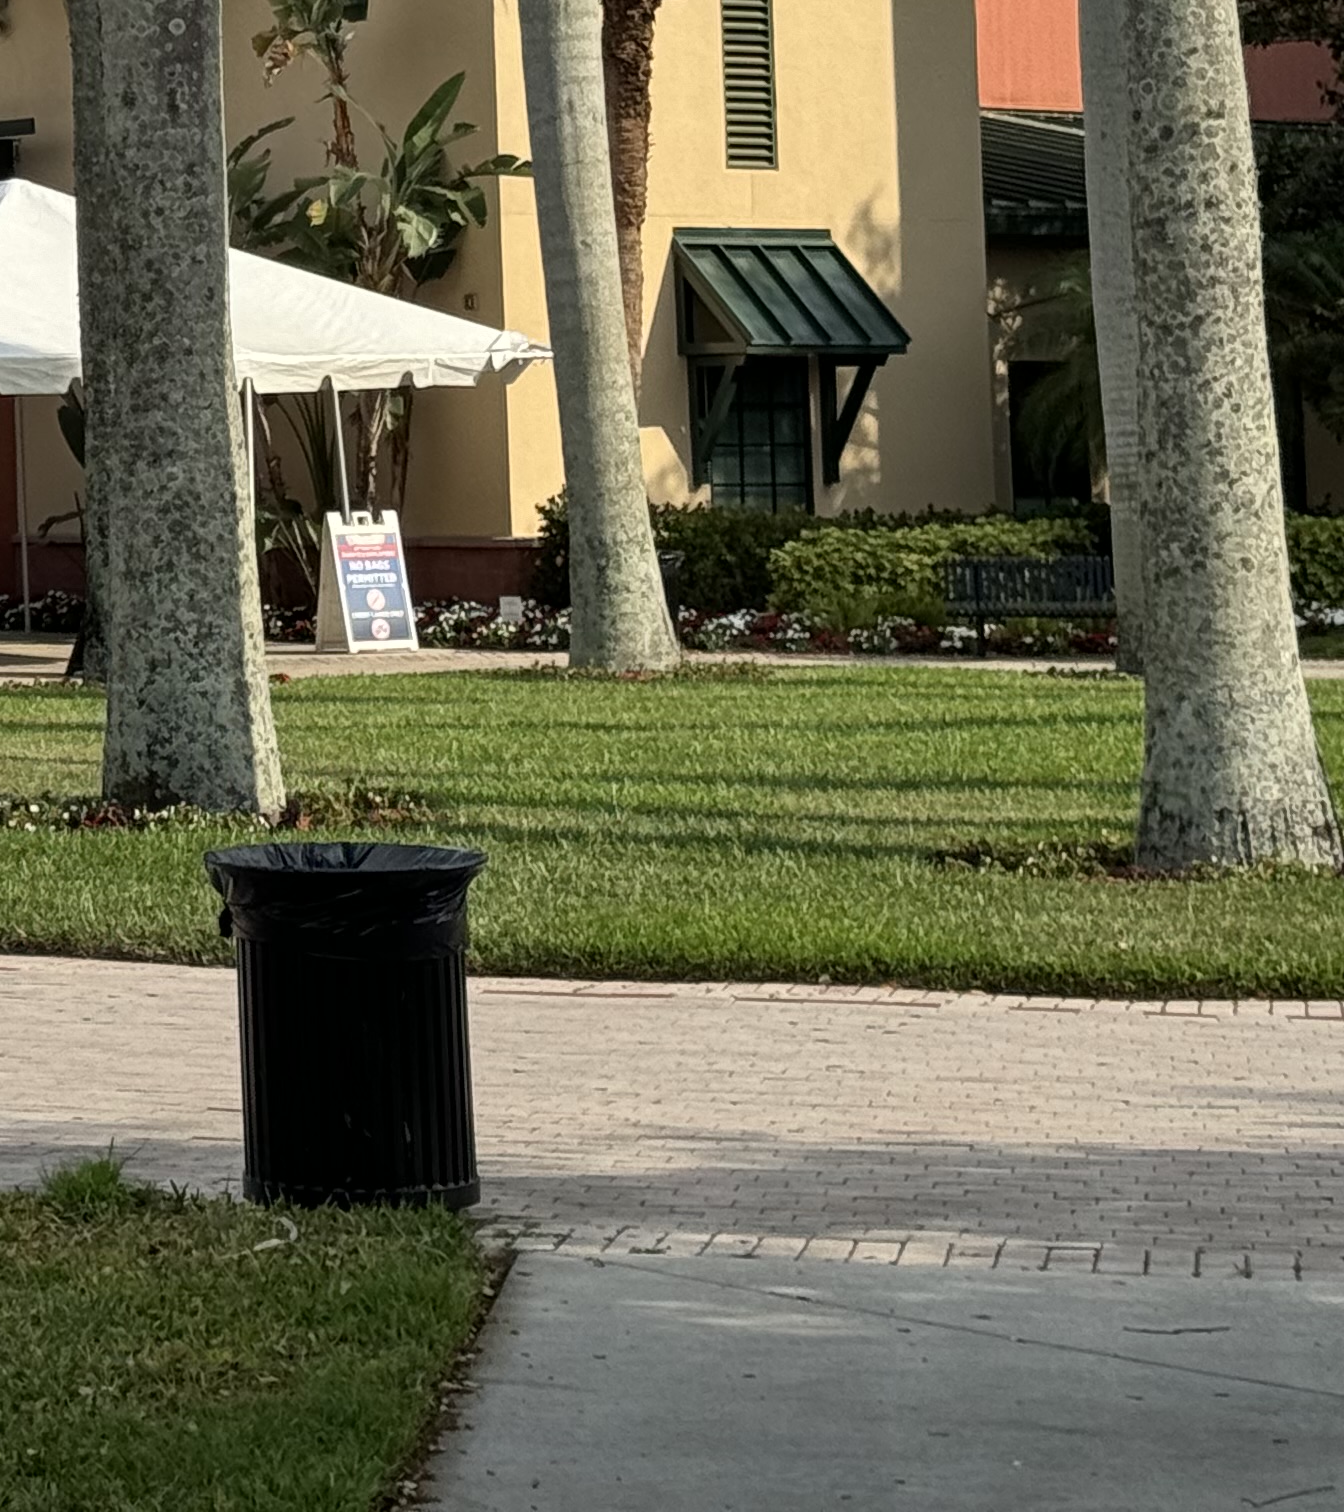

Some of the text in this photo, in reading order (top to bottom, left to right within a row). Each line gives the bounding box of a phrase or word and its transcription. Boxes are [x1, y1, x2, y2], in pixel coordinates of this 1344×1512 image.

[349, 560, 390, 571] NO BAGS
[346, 573, 397, 584] PERMITTED
